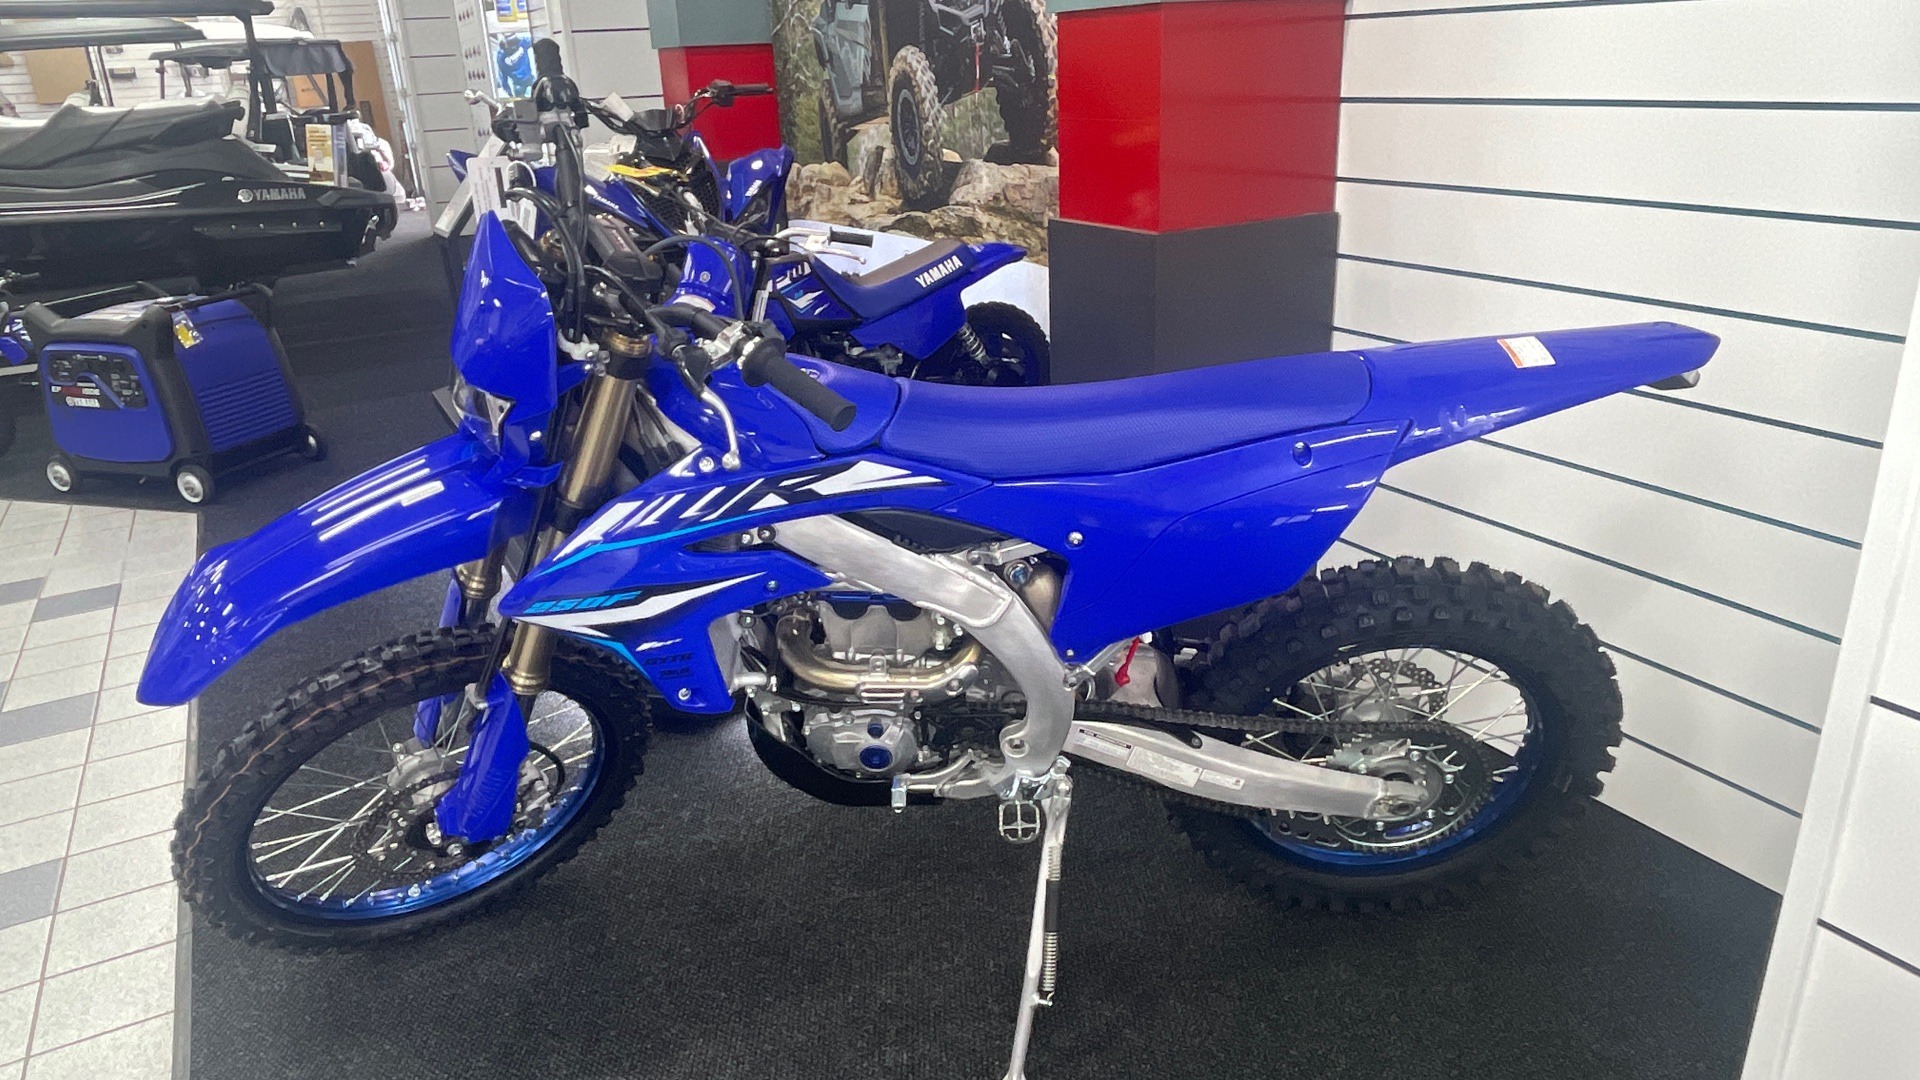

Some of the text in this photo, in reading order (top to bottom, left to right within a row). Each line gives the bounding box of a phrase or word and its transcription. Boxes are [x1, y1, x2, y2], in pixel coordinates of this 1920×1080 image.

[253, 187, 306, 200] YAMAHA
[914, 255, 964, 288] YAMAHA
[523, 590, 643, 614] 250F
